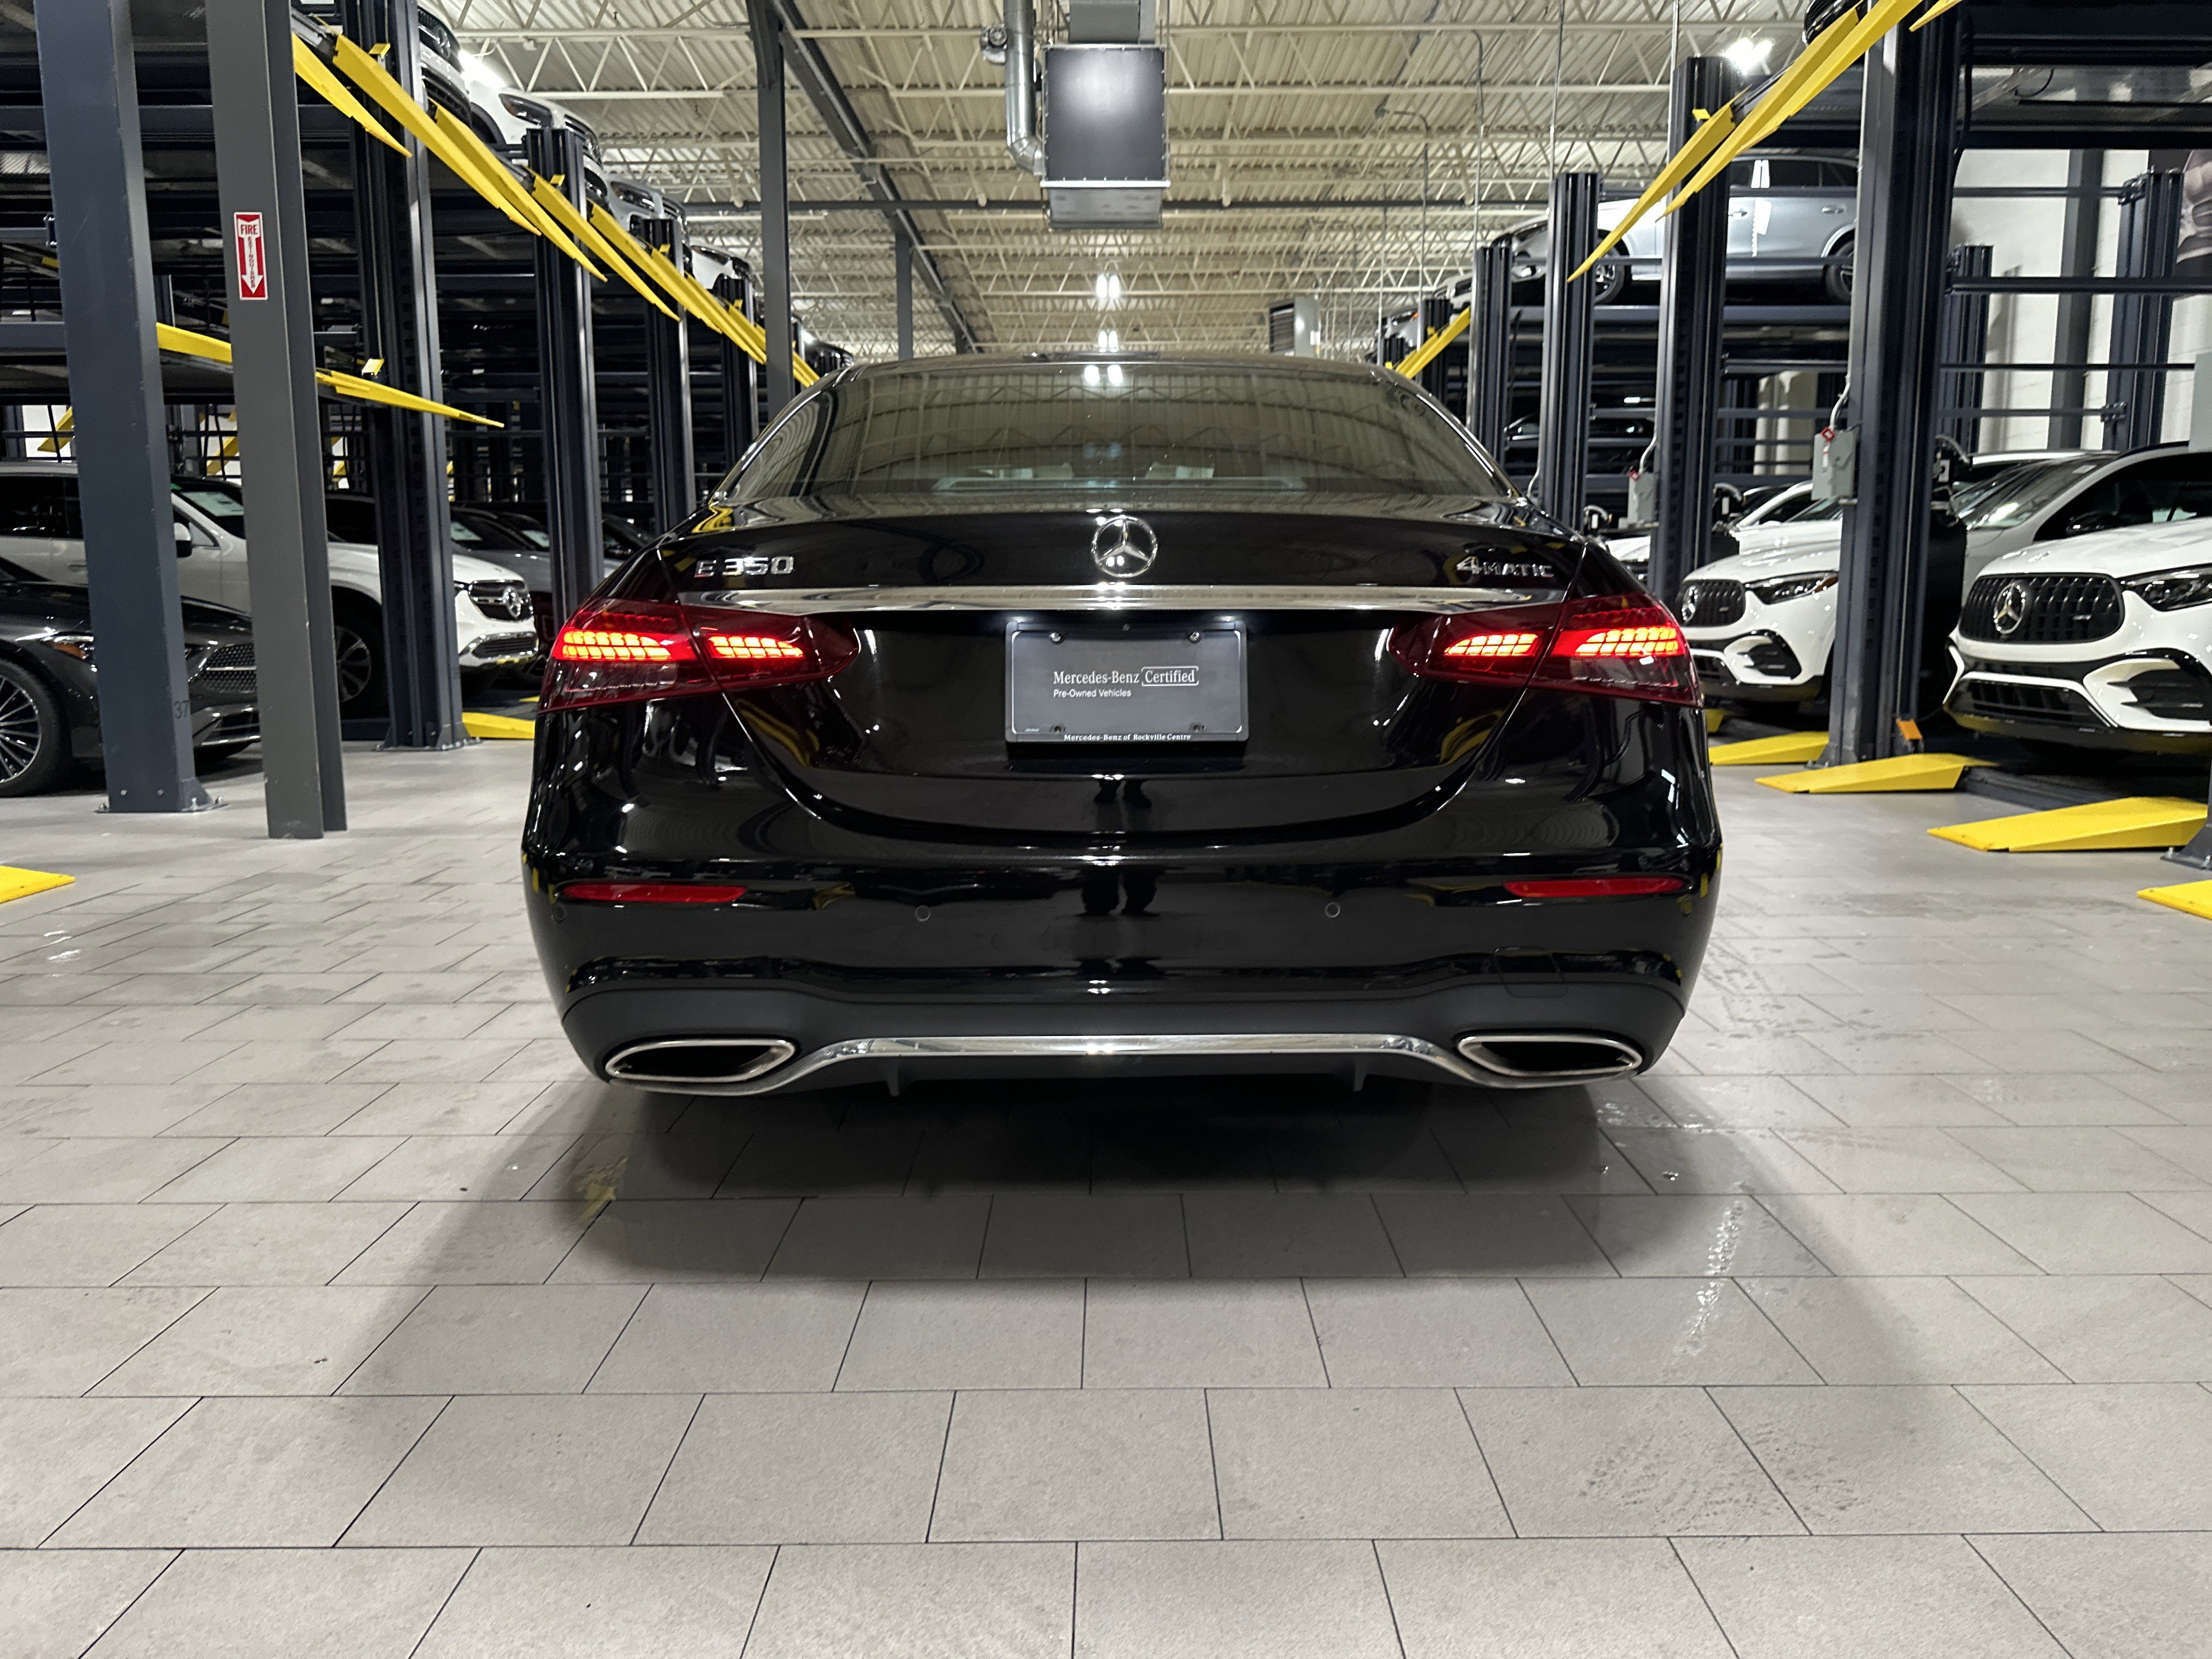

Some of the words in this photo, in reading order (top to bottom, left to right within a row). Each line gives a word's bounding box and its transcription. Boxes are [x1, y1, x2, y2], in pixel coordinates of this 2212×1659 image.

[240, 224, 258, 235] FIRE
[695, 559, 717, 578] E
[723, 556, 795, 575] 350
[1456, 555, 1555, 578] 4MATIC
[1053, 670, 1140, 684] Mercedes-Benz
[1144, 669, 1195, 684] Certified
[1053, 689, 1097, 698] Pre-Owned
[1098, 688, 1132, 697] Vehicles
[174, 700, 190, 719] 37
